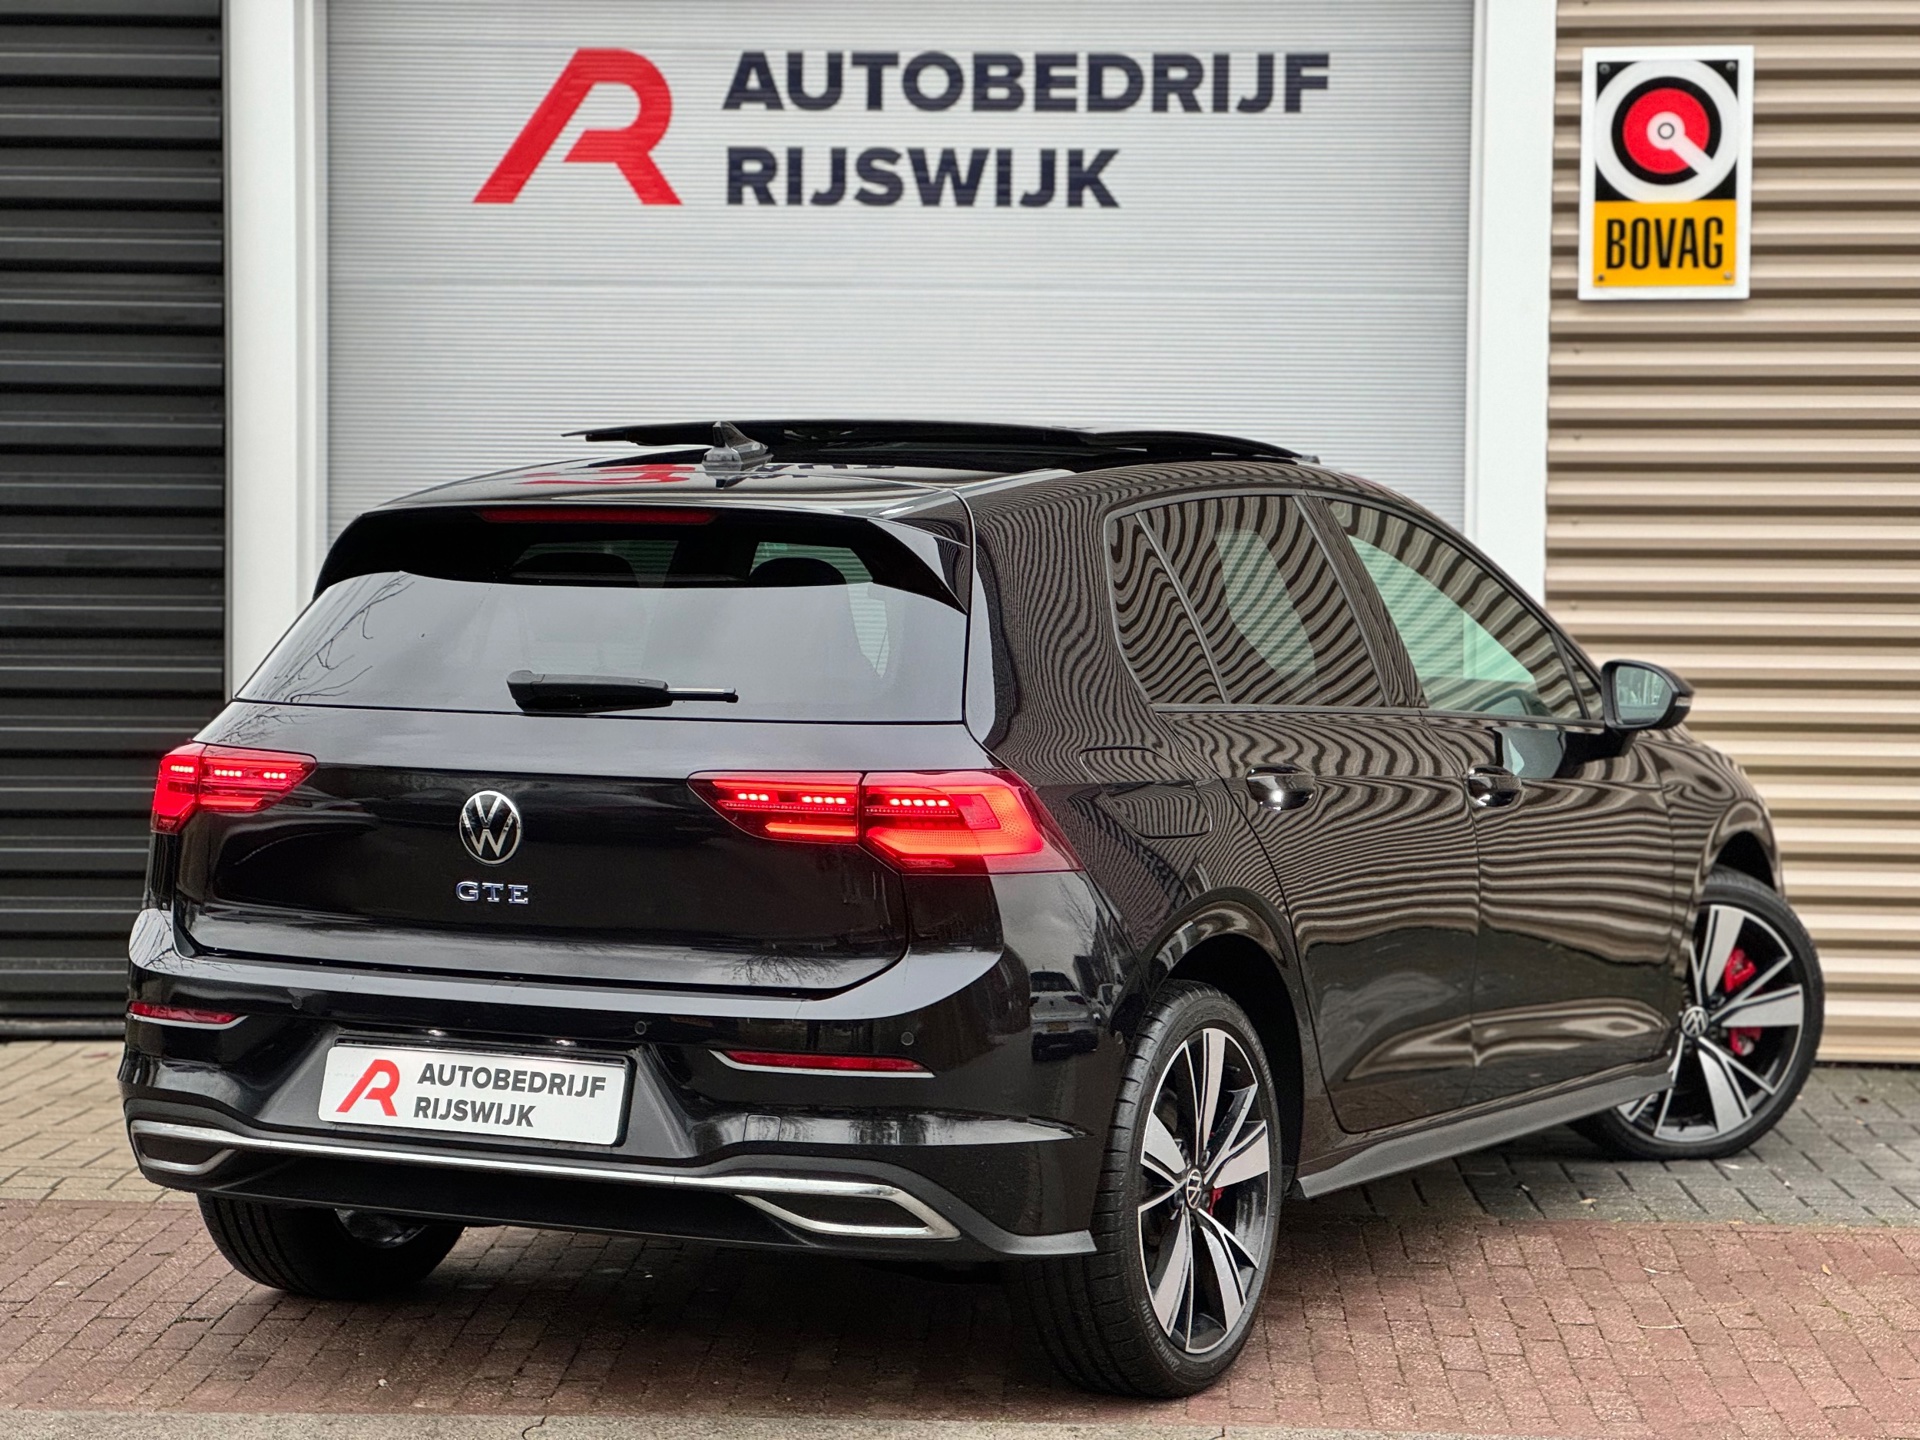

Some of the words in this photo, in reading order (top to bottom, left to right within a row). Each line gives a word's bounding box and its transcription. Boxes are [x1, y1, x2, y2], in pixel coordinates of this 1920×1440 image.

[723, 50, 1330, 113] AUTOBEDRIJF
[728, 147, 1120, 208] RIJSWIJK
[1605, 216, 1724, 270] BOVAG
[455, 880, 529, 905] GTE
[417, 1062, 607, 1099] AUTOBEDRIJF
[413, 1096, 536, 1128] RIJSWIJK
